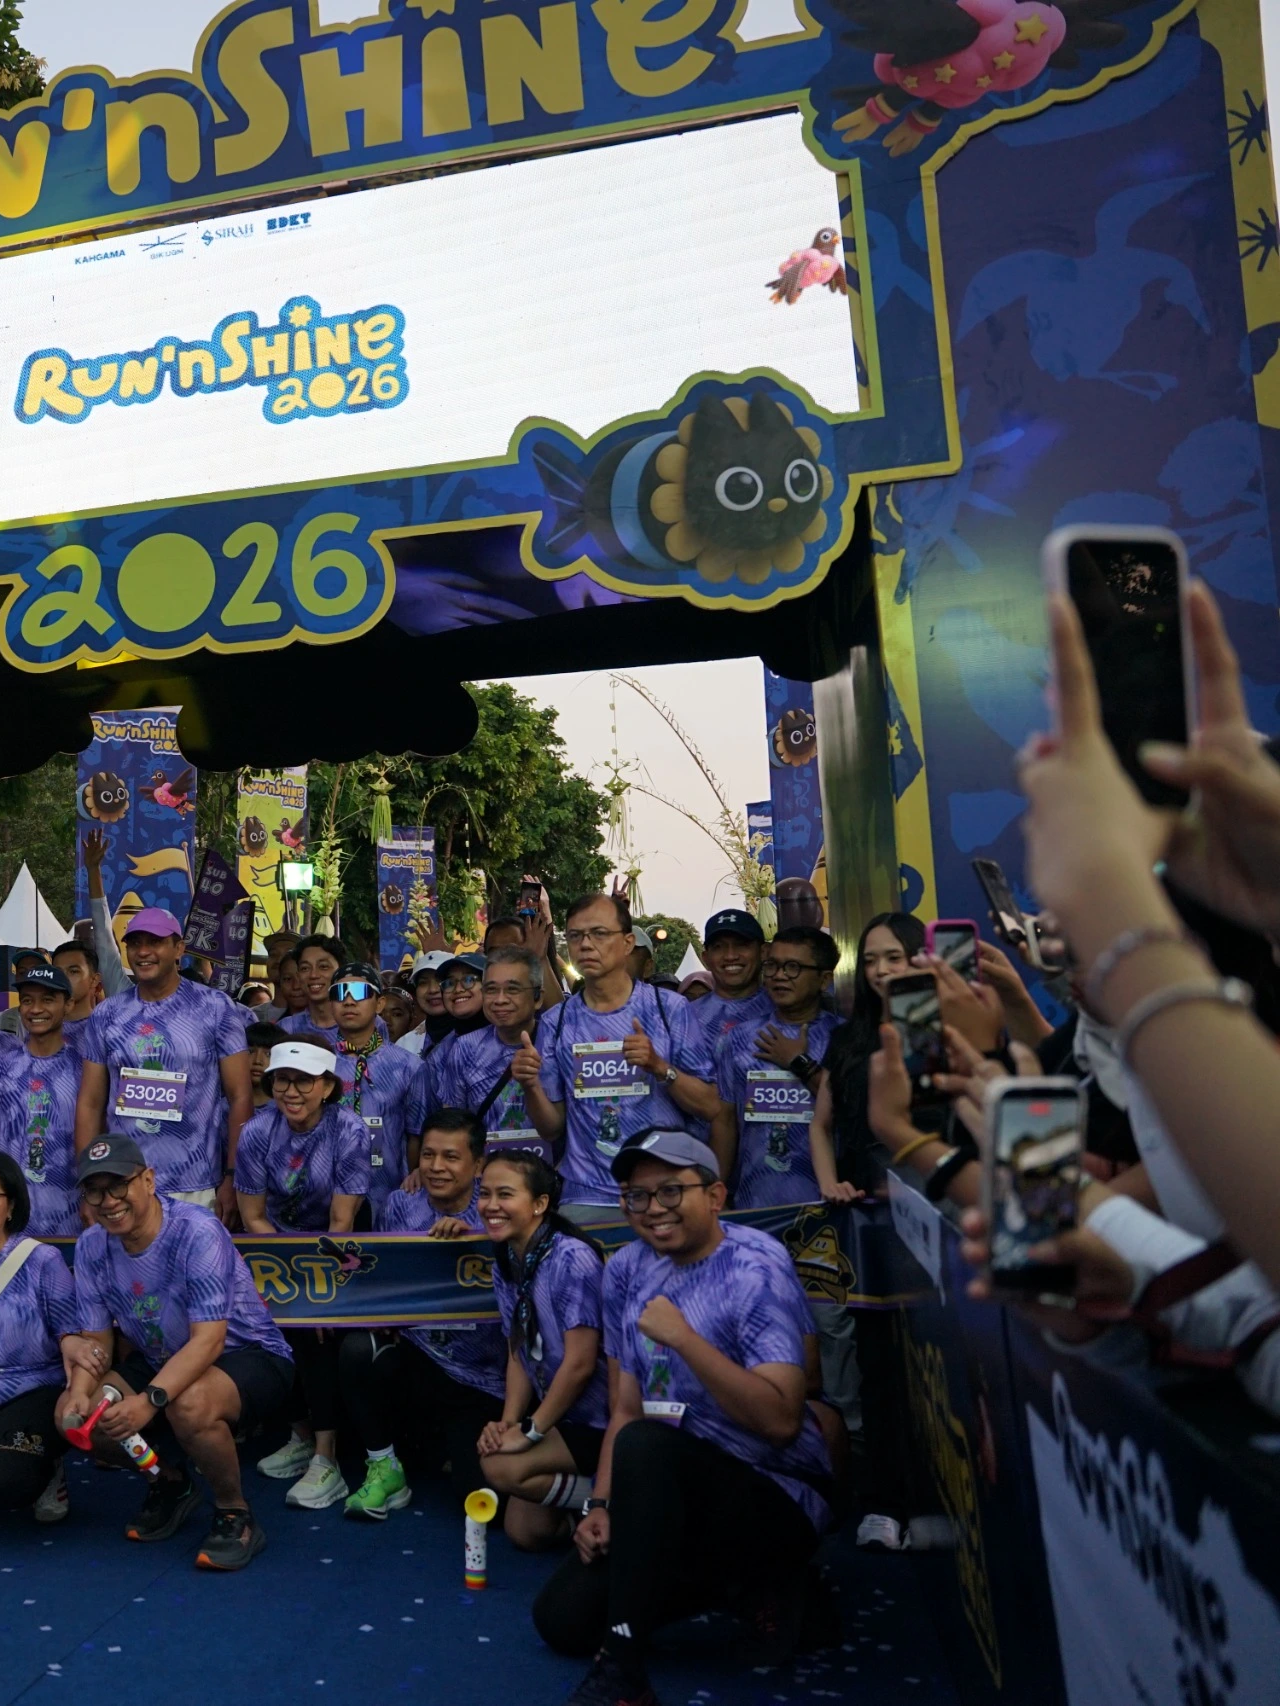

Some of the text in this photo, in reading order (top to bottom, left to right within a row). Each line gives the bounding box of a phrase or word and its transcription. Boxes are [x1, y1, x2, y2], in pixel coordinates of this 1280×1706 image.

[74, 249, 126, 265] KAHGAMA
[272, 363, 400, 416] 2026
[21, 512, 369, 648] 2026
[154, 740, 180, 752] 202
[206, 867, 227, 880] SUB
[200, 876, 225, 896] 40
[230, 914, 248, 924] SUB
[184, 925, 214, 950] 5K
[228, 927, 248, 941] 40
[27, 969, 54, 979] UGM
[218, 972, 245, 994] 5K
[124, 1083, 177, 1103] 53026
[754, 1087, 811, 1104] 53032
